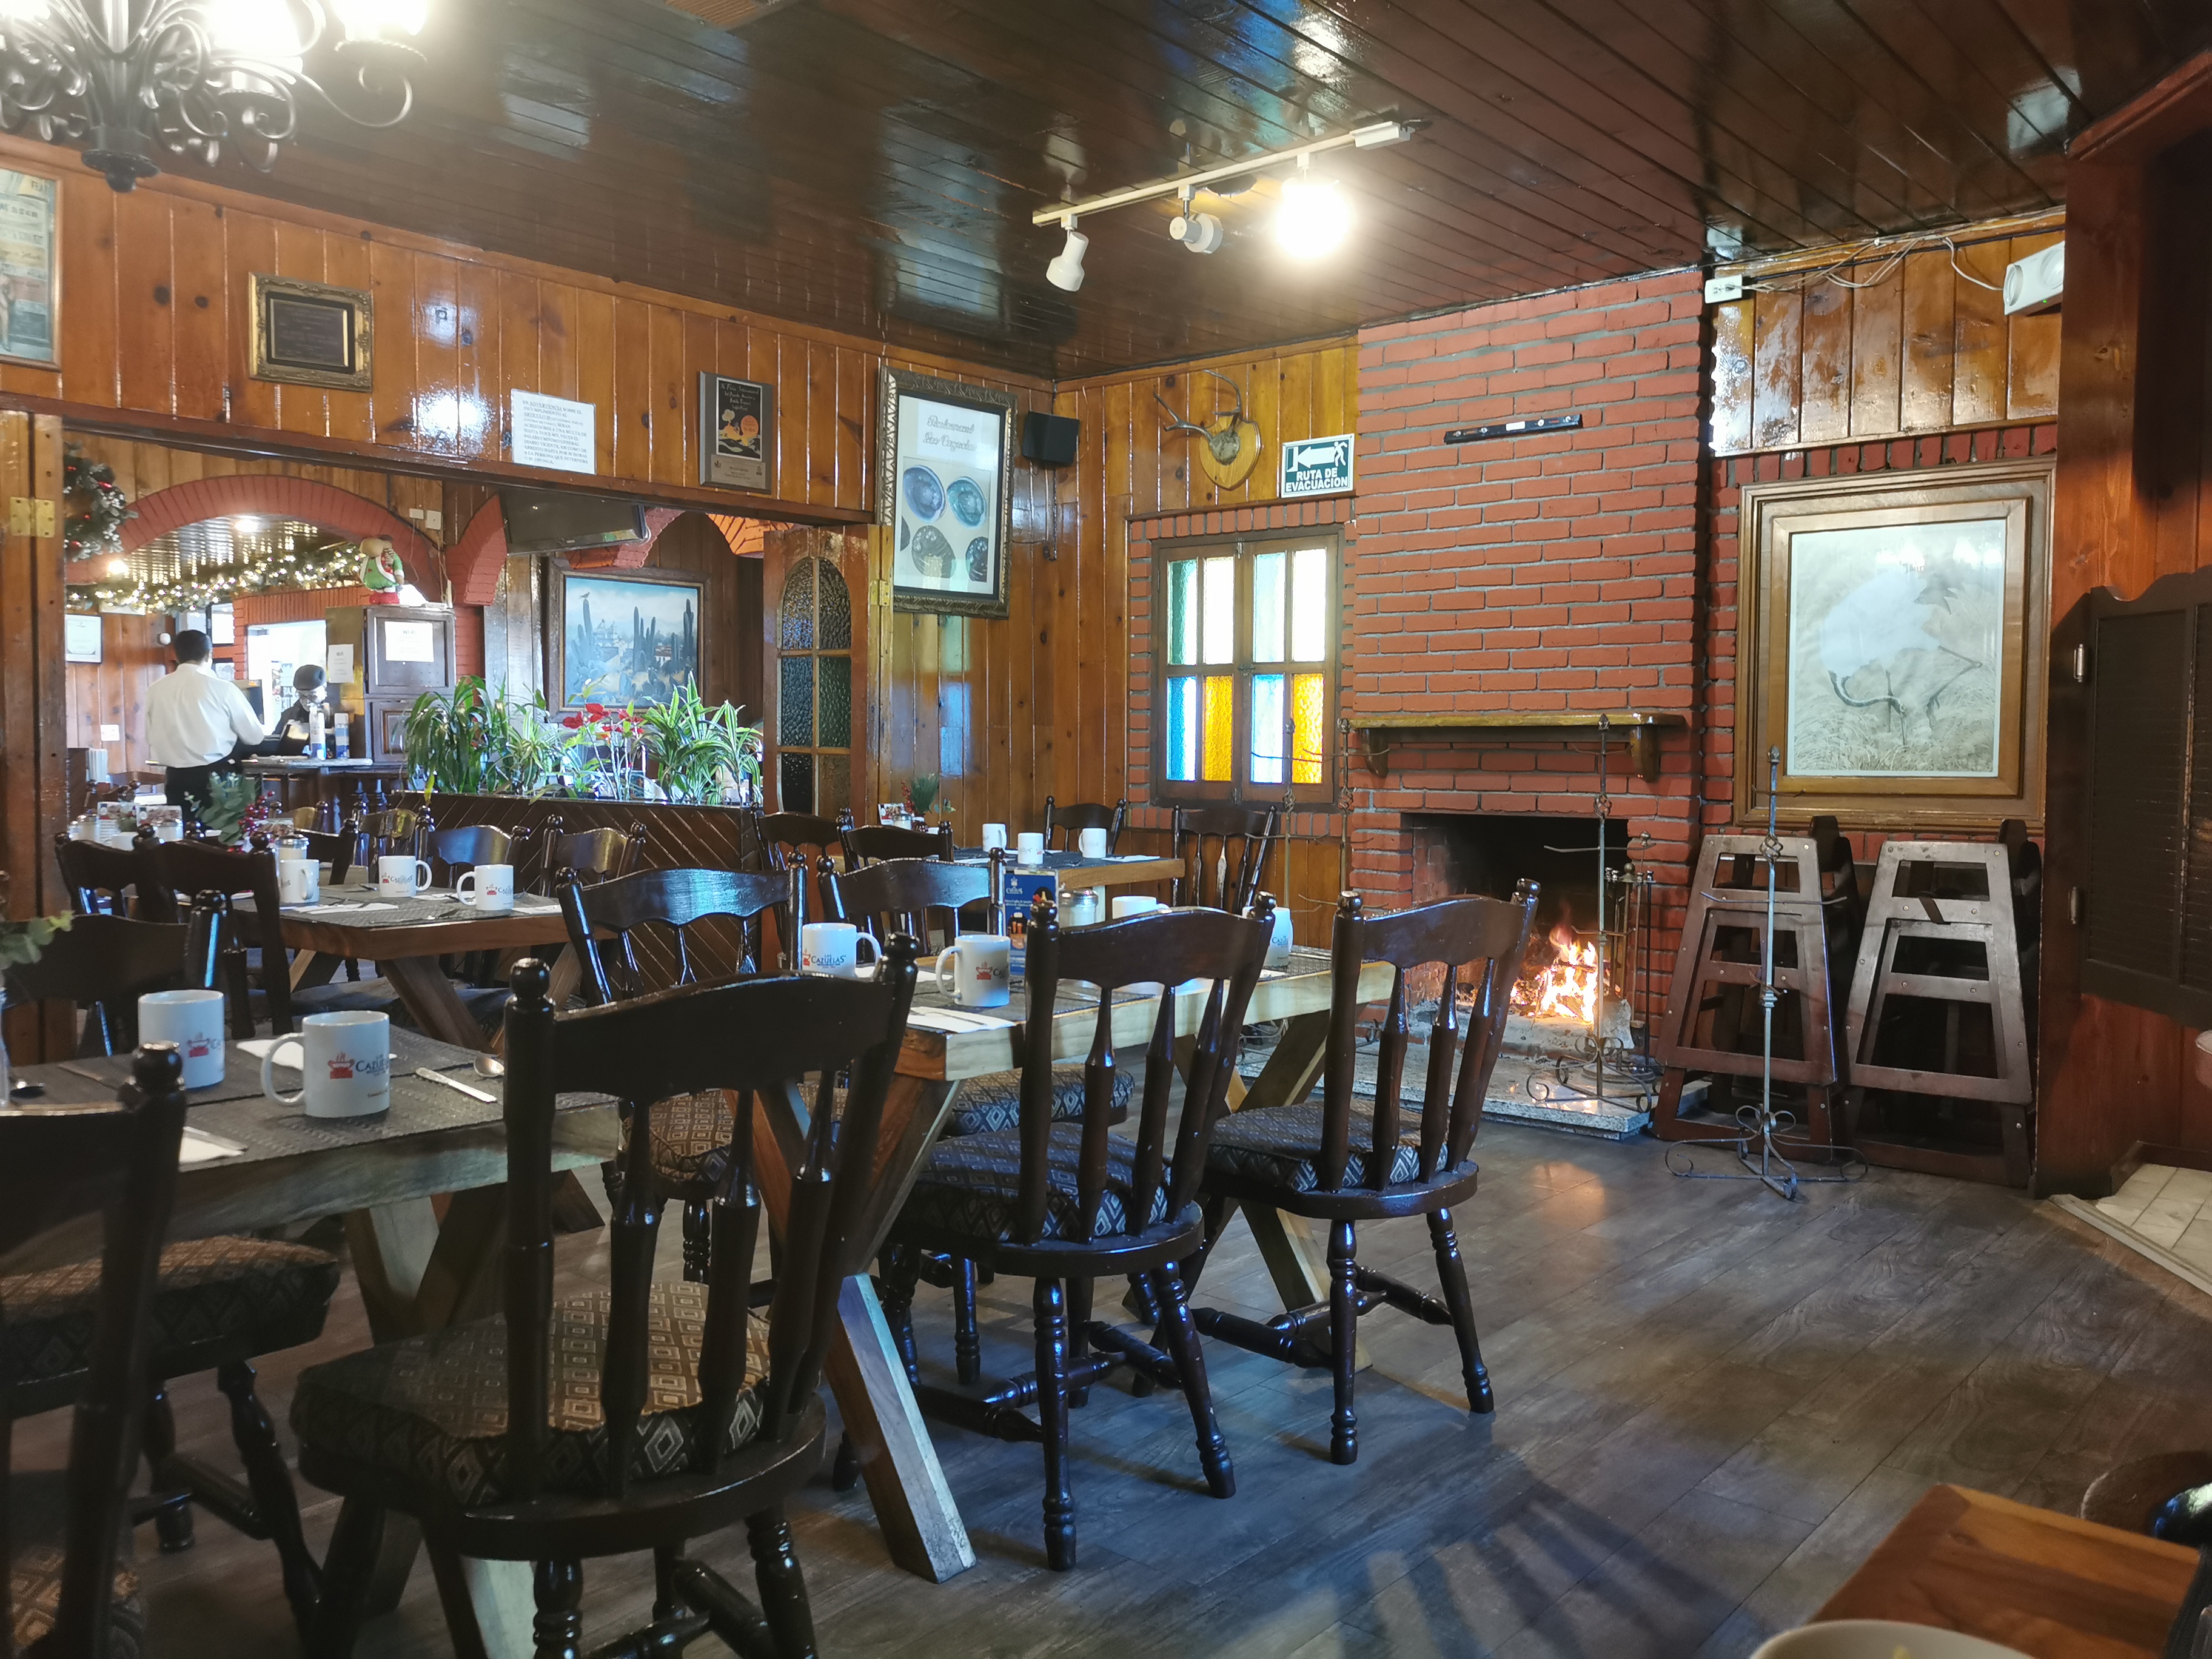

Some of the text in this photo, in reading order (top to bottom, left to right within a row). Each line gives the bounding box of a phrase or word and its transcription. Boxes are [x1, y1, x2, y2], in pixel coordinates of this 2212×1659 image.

[524, 406, 561, 416] INCUMPLIMIENTO
[530, 401, 562, 411] ADVERTENCIA
[1296, 468, 1338, 481] RUTA DE
[1285, 477, 1348, 492] EVACUACION
[811, 954, 845, 964] CAZUELAS
